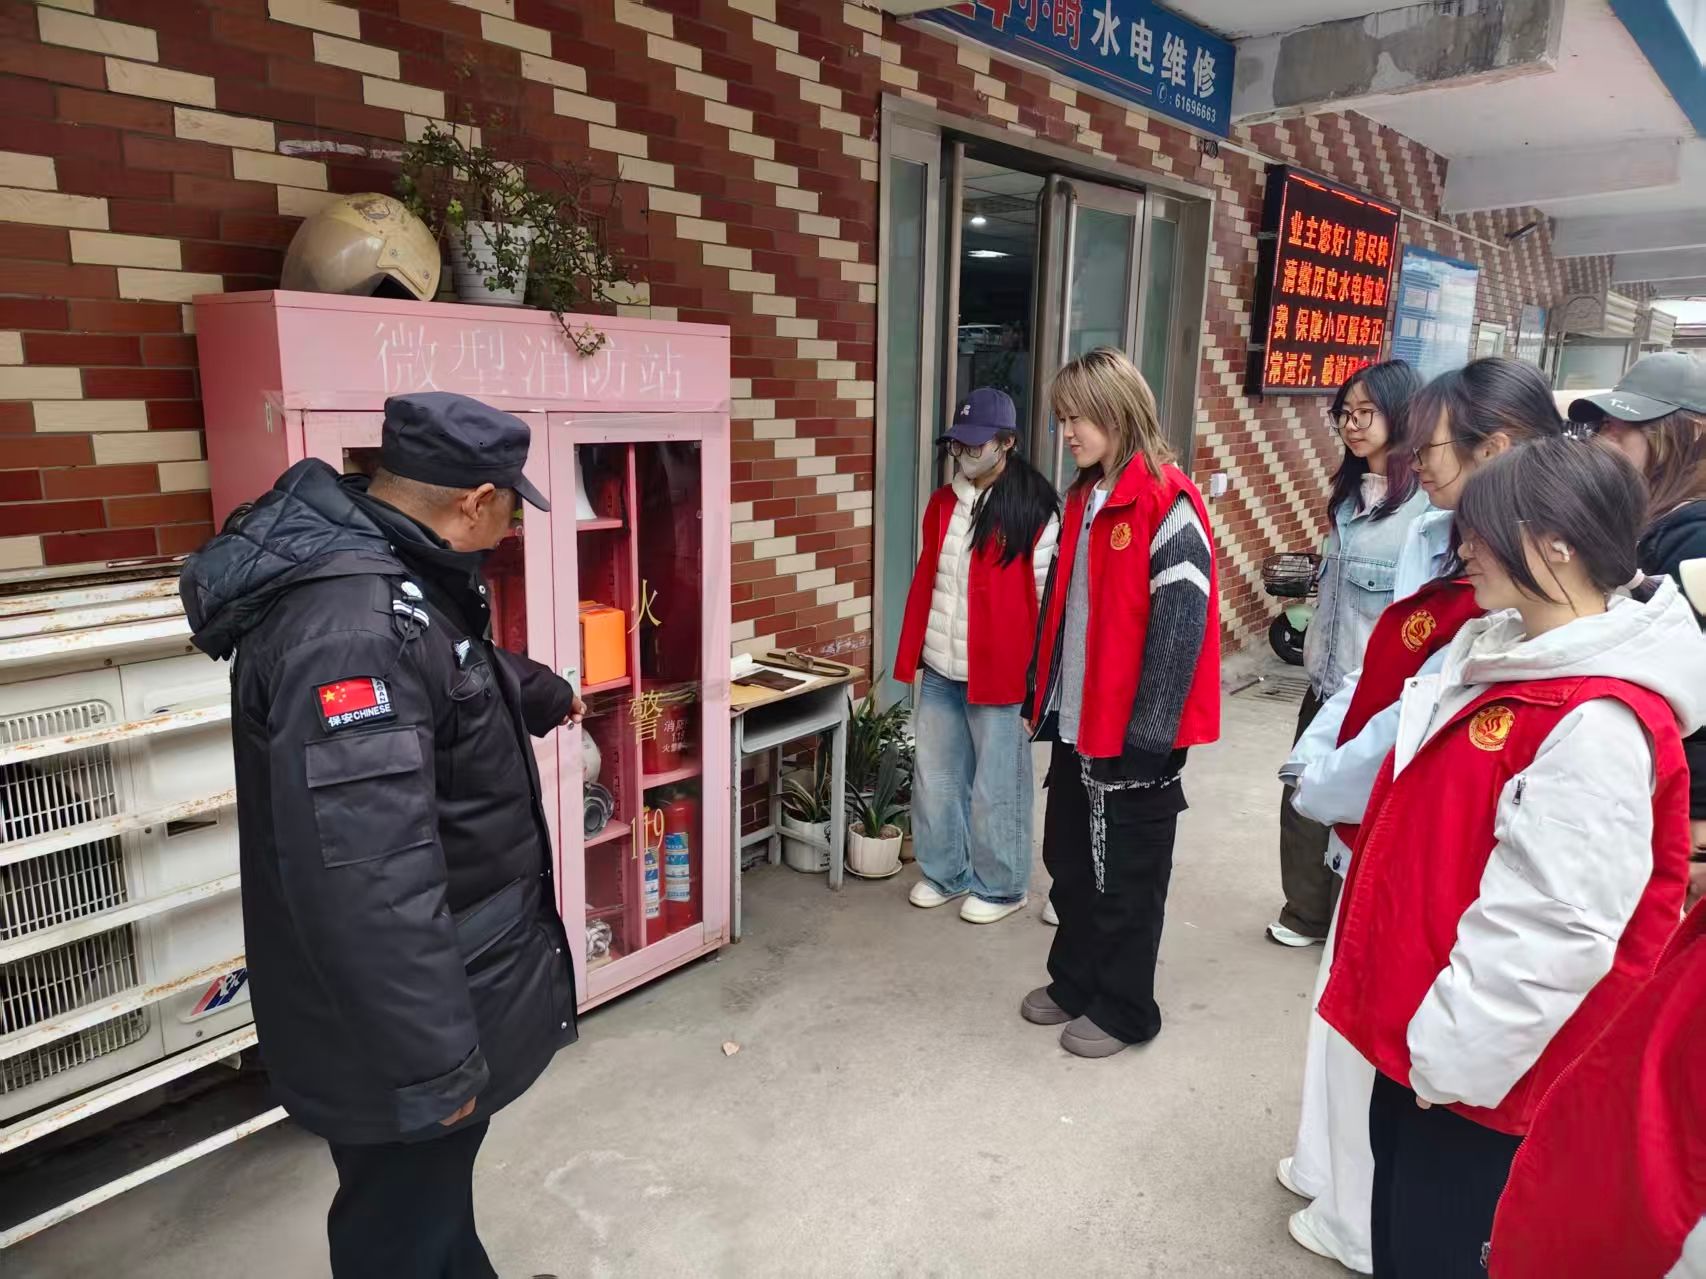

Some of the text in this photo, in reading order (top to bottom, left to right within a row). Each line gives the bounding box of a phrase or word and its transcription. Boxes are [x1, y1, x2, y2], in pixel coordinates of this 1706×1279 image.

[374, 321, 683, 399] 微型消防站
[630, 808, 665, 860] 119
